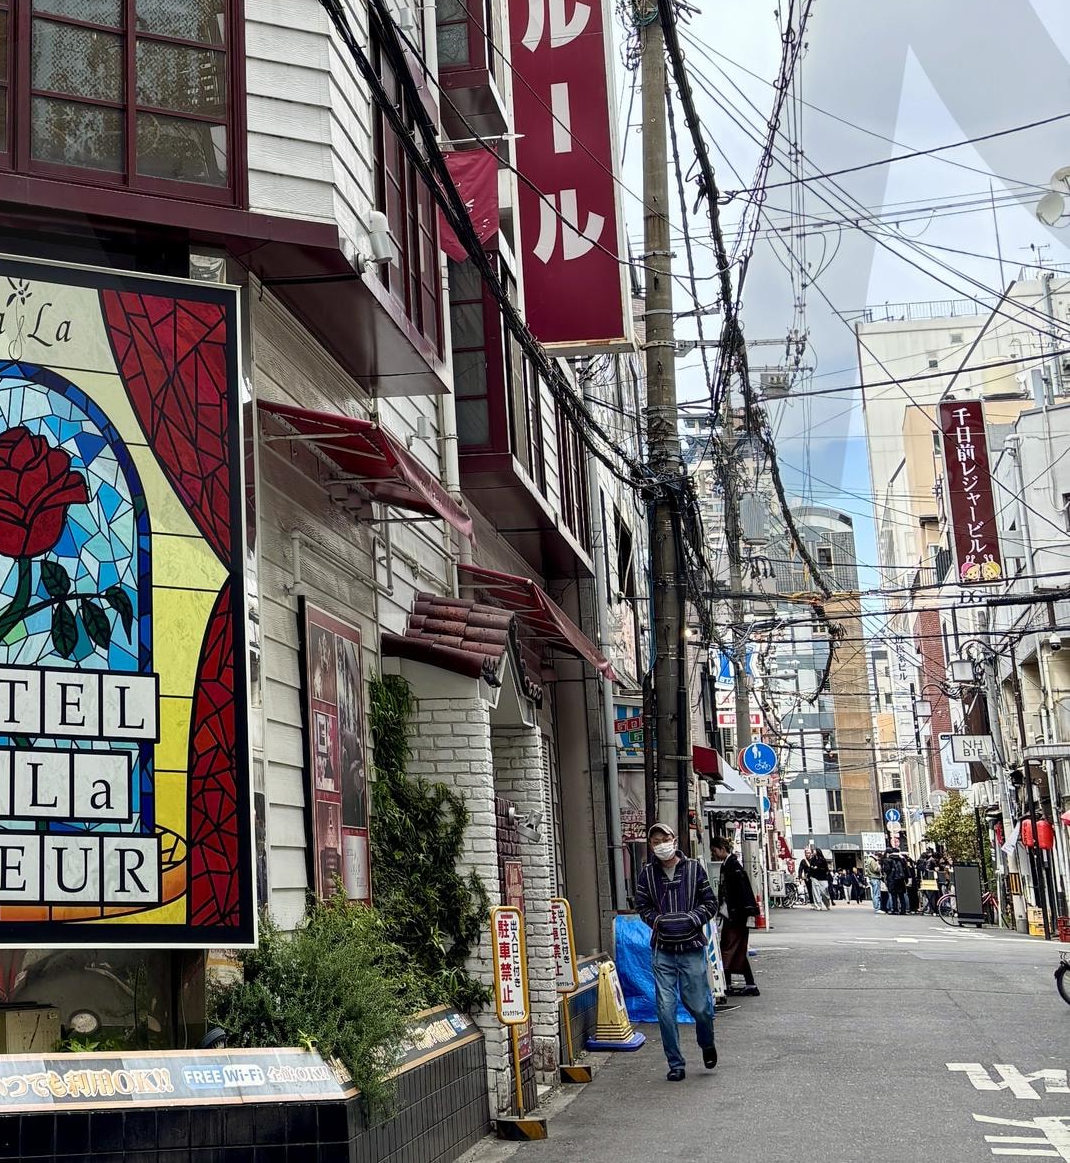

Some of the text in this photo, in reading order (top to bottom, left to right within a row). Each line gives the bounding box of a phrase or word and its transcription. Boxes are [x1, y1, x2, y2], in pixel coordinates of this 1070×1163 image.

[952, 407, 987, 554] 千日前レジャービル
[962, 739, 983, 749] NH
[497, 920, 514, 1003] 駐車禁止
[510, 920, 521, 988] 出入口に付き
[183, 1069, 223, 1085] FREE
[224, 1067, 264, 1083] Wi-Fi
